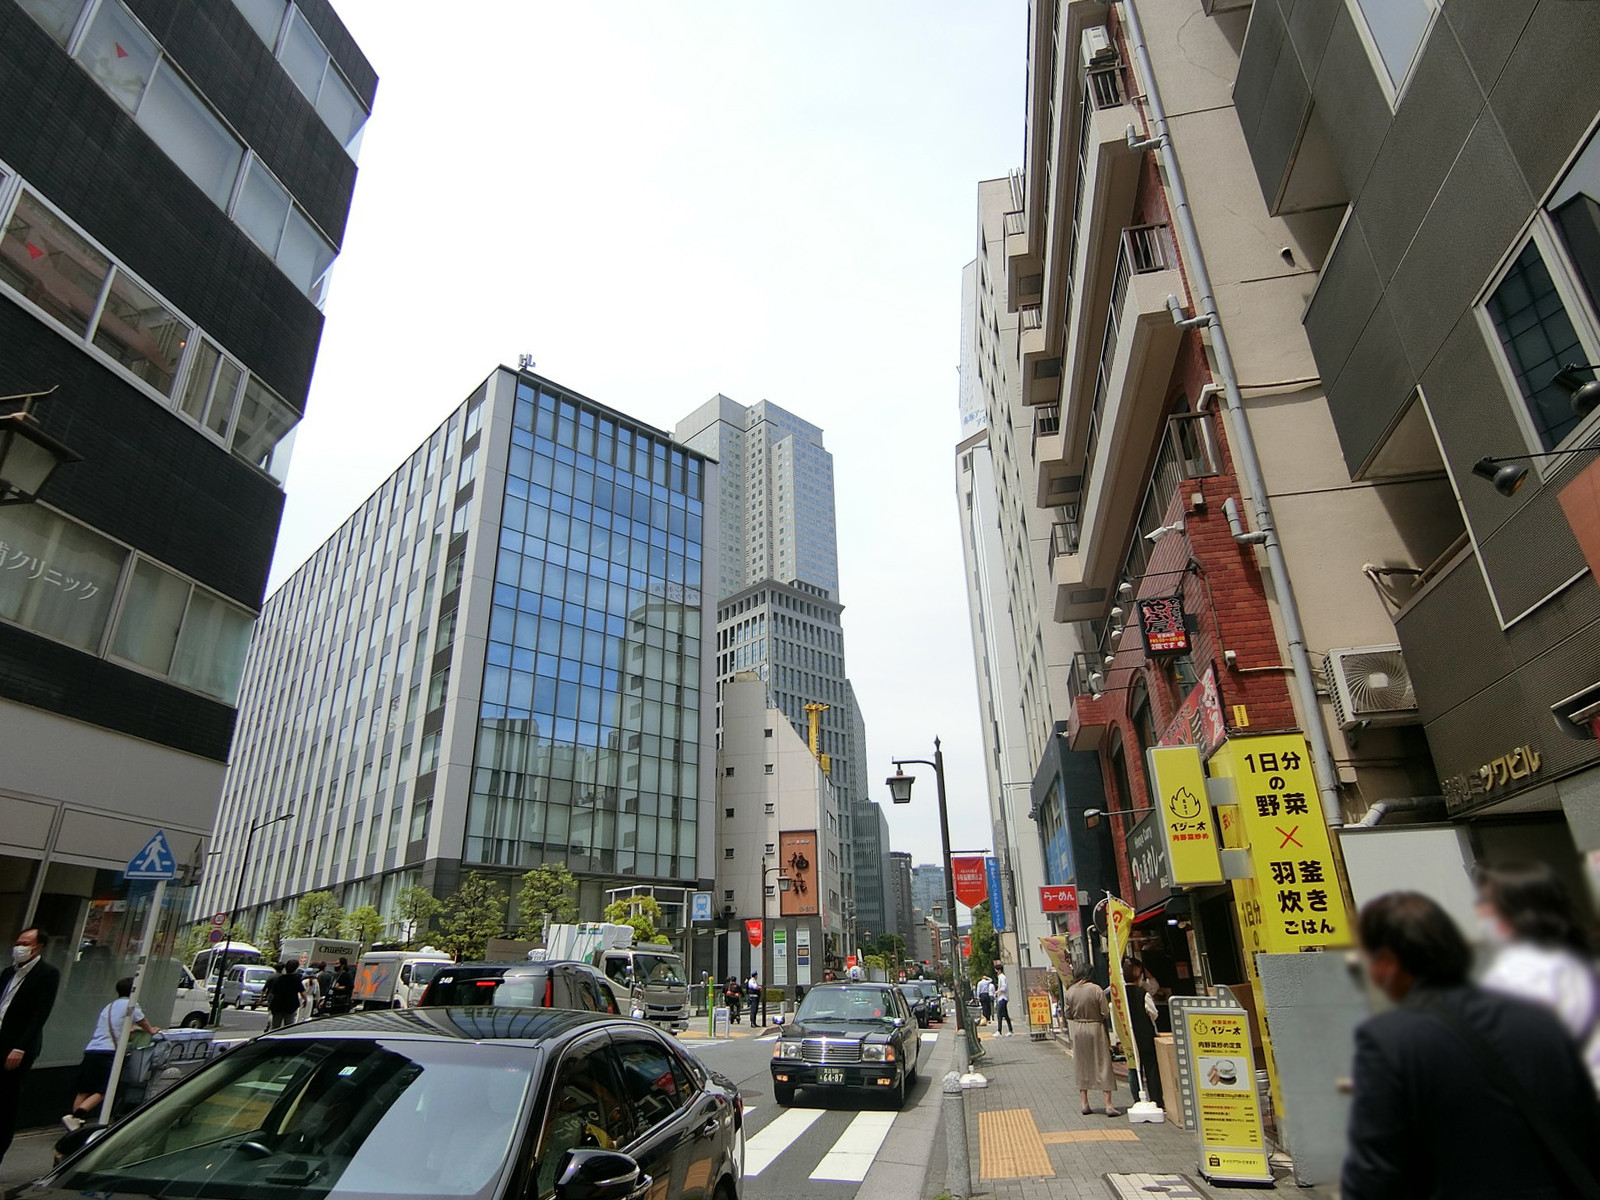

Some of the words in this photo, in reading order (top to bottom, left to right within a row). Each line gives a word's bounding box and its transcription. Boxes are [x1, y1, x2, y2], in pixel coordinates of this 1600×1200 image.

[1244, 752, 1301, 773] 1日分
[1269, 776, 1285, 790] の
[1256, 792, 1309, 817] 野菜
[1270, 860, 1325, 885] 羽釜
[1043, 891, 1075, 901] らーめん
[1277, 890, 1328, 914] 炊き
[1284, 918, 1335, 935] ごはん
